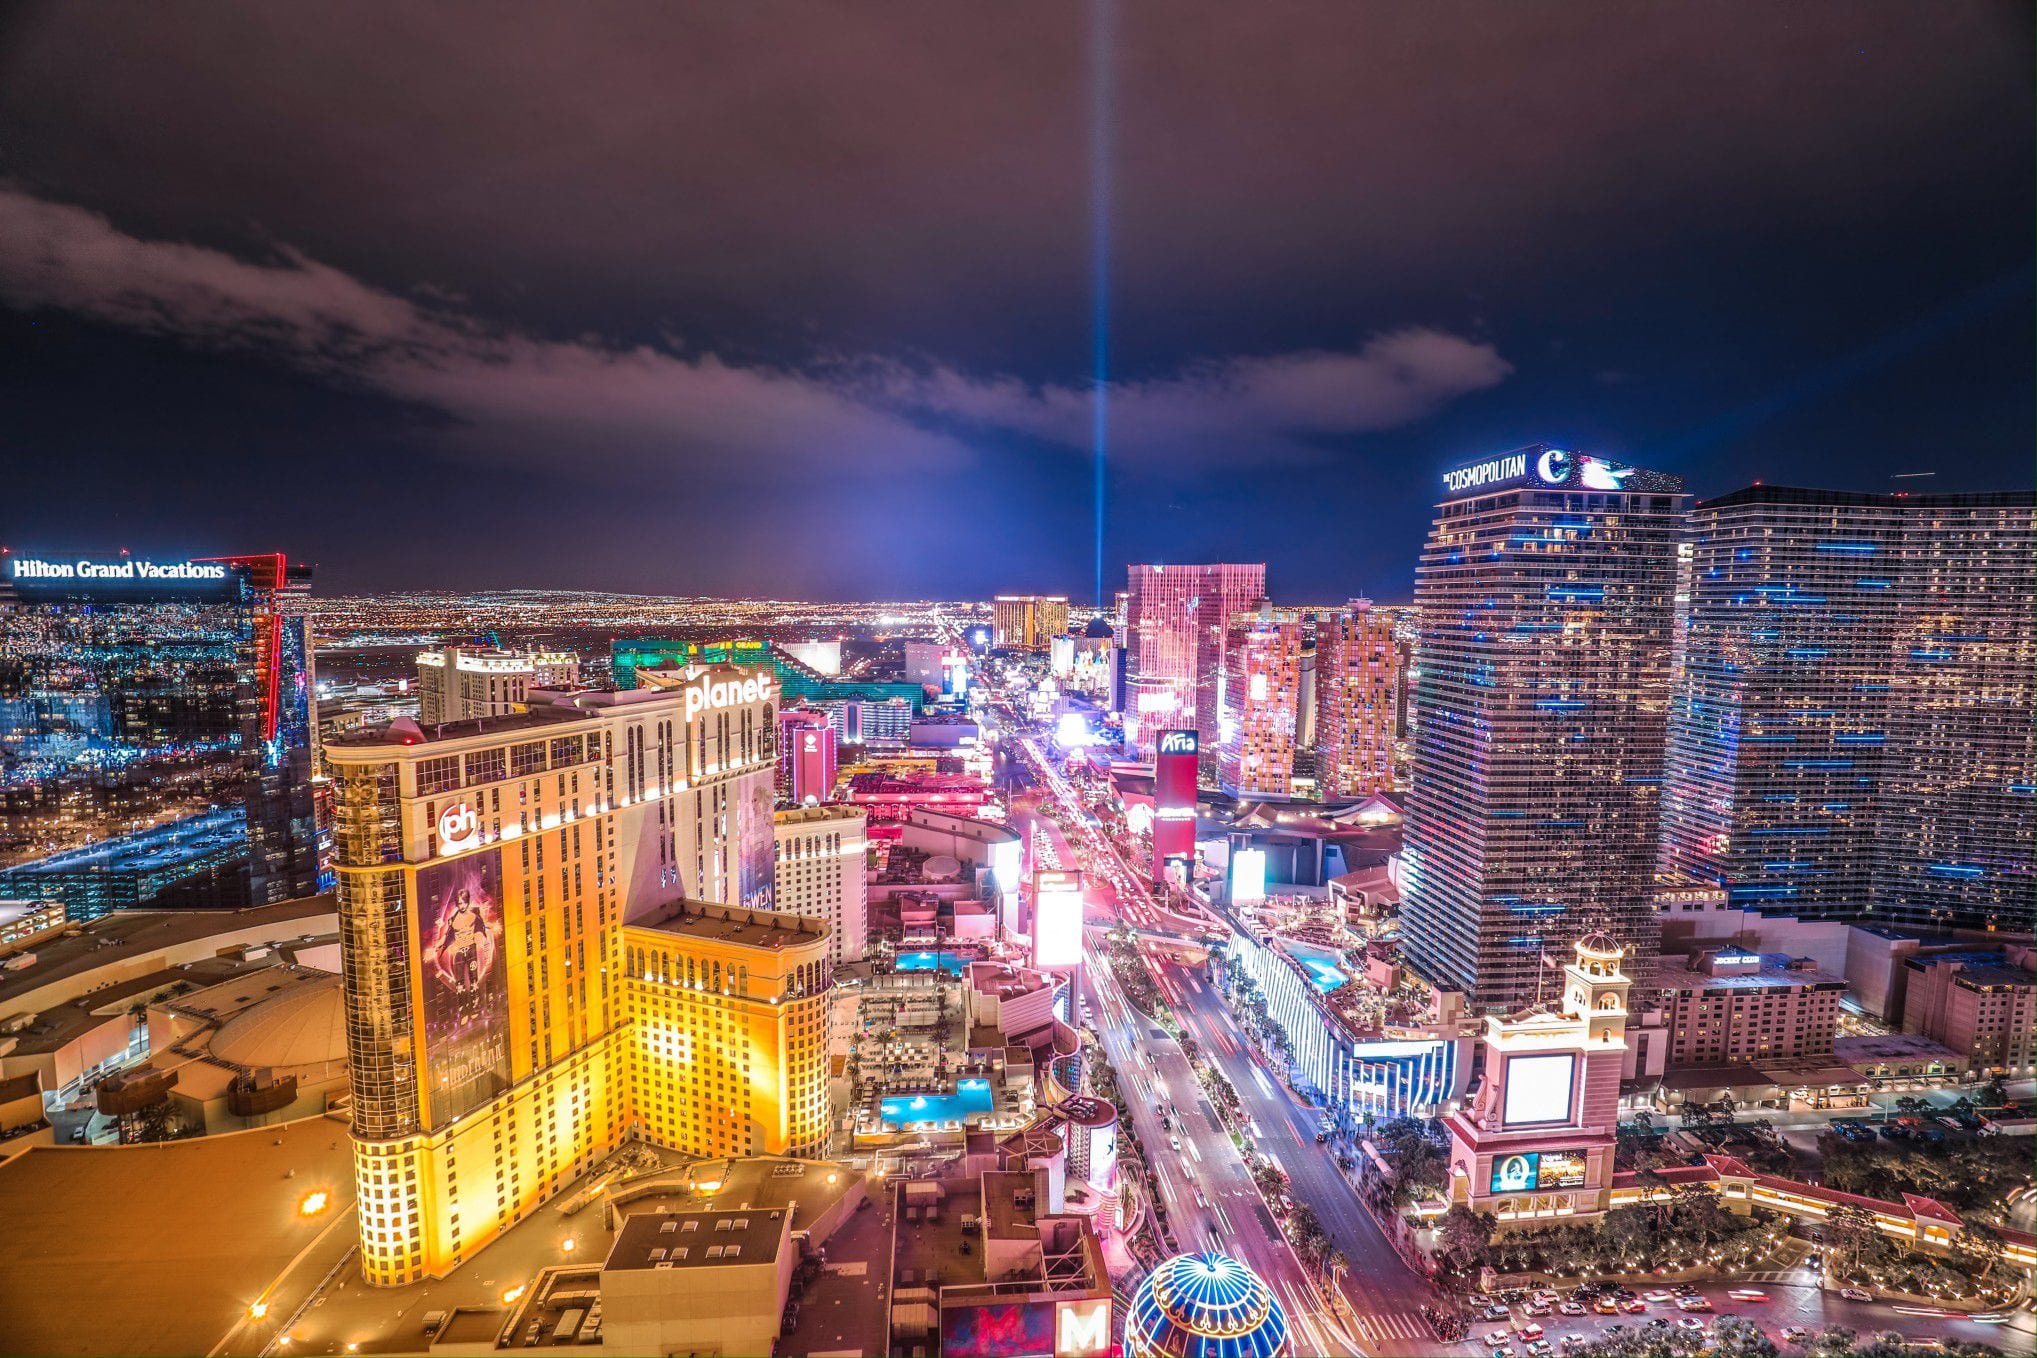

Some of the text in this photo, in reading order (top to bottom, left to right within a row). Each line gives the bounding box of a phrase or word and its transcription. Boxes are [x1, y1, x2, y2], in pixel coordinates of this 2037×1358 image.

[1450, 454, 1526, 491] COSMOPOLITAN
[1537, 449, 1568, 483] C
[14, 560, 225, 579] Hilton Grand Vacations
[735, 641, 763, 649] GRAND
[685, 672, 771, 722] planet
[1161, 734, 1195, 752] Aria
[444, 802, 477, 841] ph
[743, 882, 772, 908] GWEN
[1713, 955, 1760, 965] JOCKEY CLUB
[1061, 1304, 1107, 1352] M
